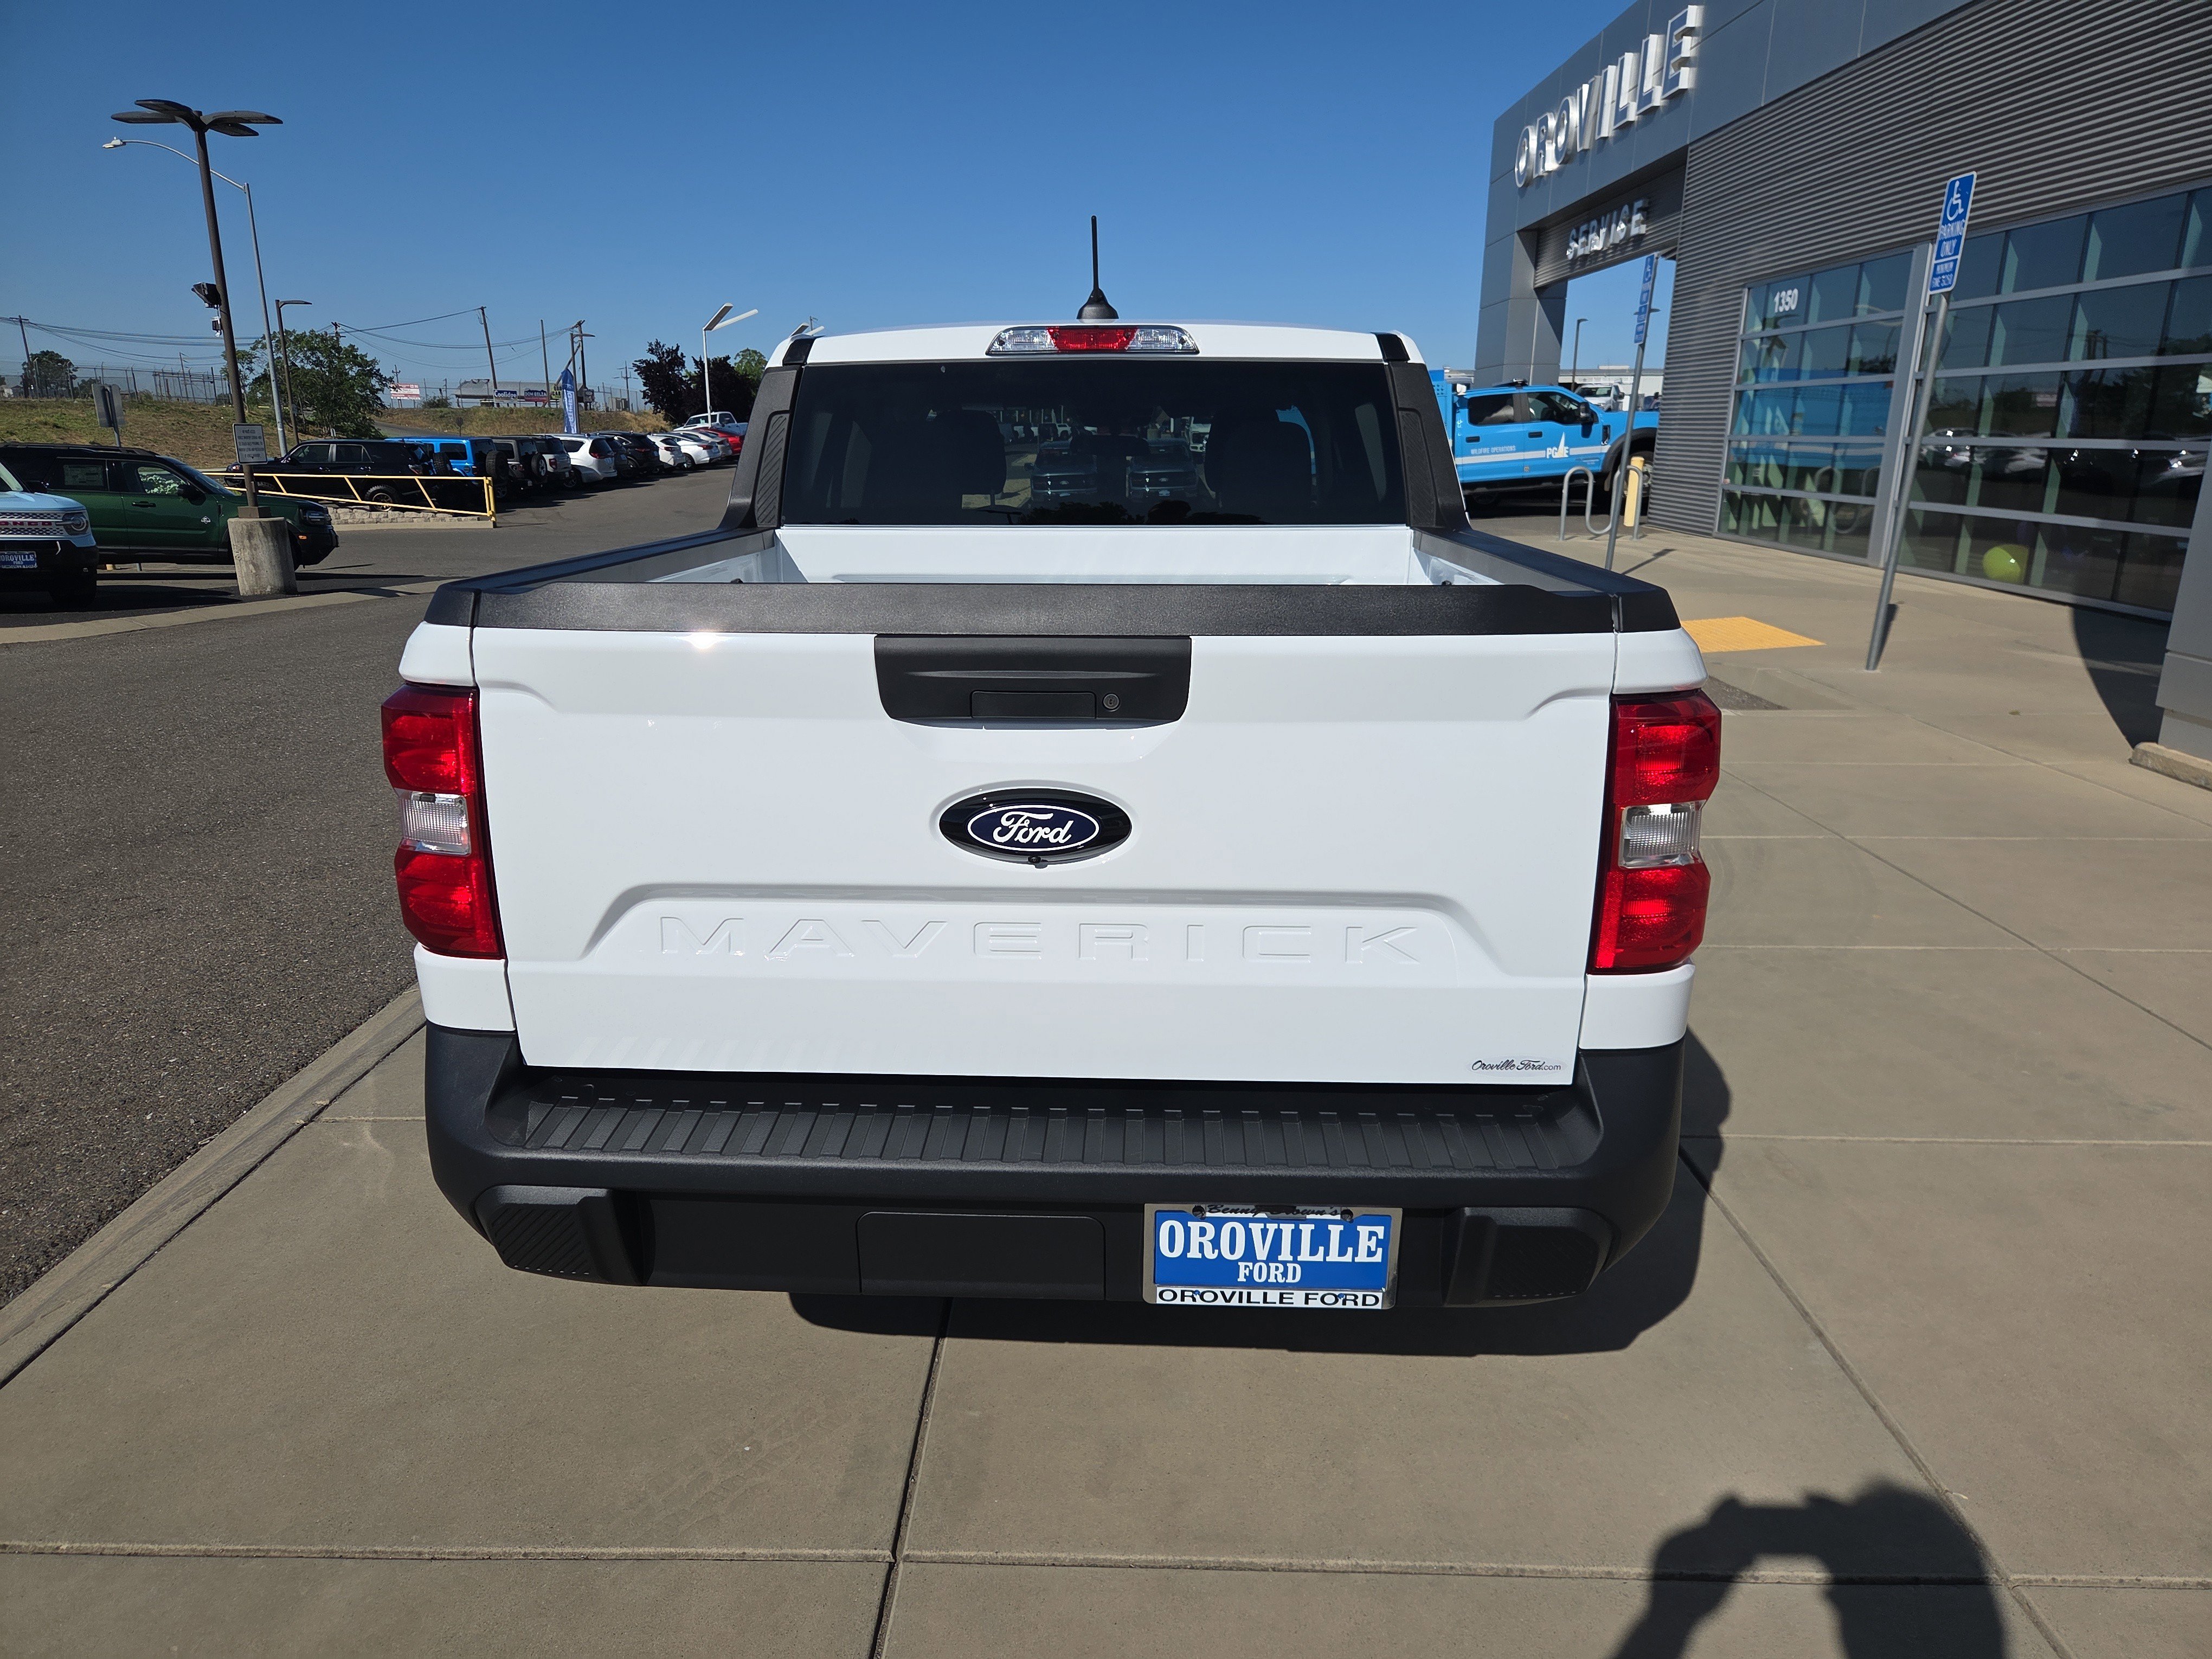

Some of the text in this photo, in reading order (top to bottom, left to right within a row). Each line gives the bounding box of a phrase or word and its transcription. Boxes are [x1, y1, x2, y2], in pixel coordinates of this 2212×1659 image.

[1515, 5, 1702, 188] OROVILLE
[1566, 198, 1647, 260] SERVICE
[1773, 288, 1798, 313] 1350
[993, 811, 1074, 844] Ford
[660, 916, 1420, 964] MAVERICK
[1471, 1059, 1516, 1071] Oroville
[1159, 1220, 1385, 1263] OROVILLE
[1237, 1262, 1302, 1283] FORD
[1159, 1288, 1380, 1308] OROVILLE FORD
